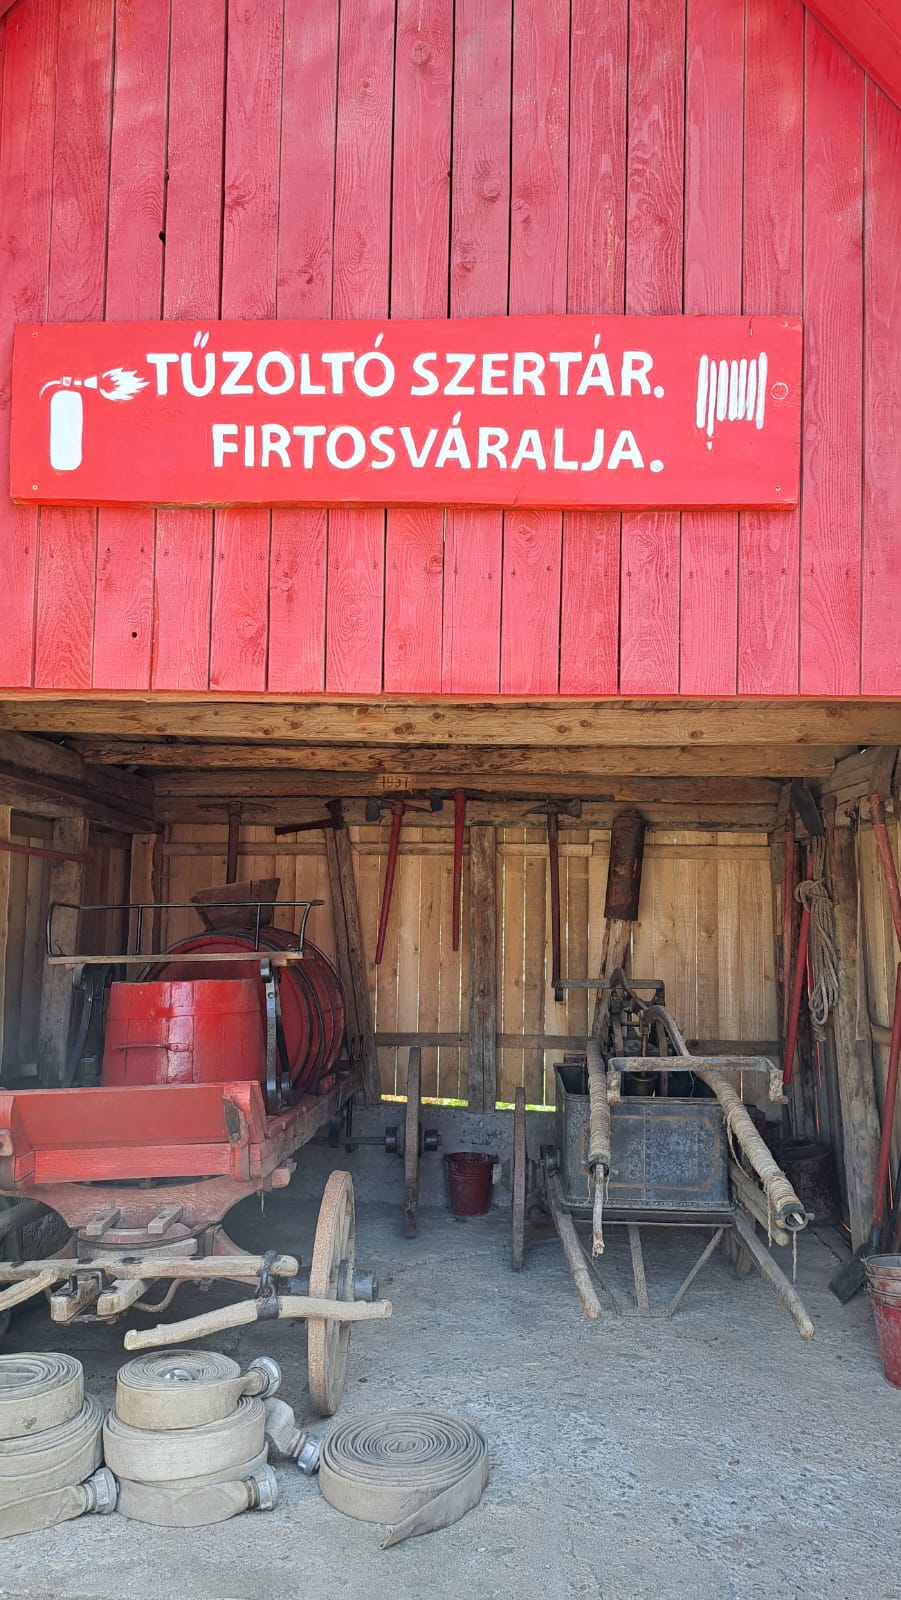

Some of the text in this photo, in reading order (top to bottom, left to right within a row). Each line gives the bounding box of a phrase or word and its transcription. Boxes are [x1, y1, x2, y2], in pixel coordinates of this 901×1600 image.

[146, 330, 666, 399] TŰZOLTÓ SZERTÁR.
[211, 410, 666, 473] FIRTOSVÁRALJA.
